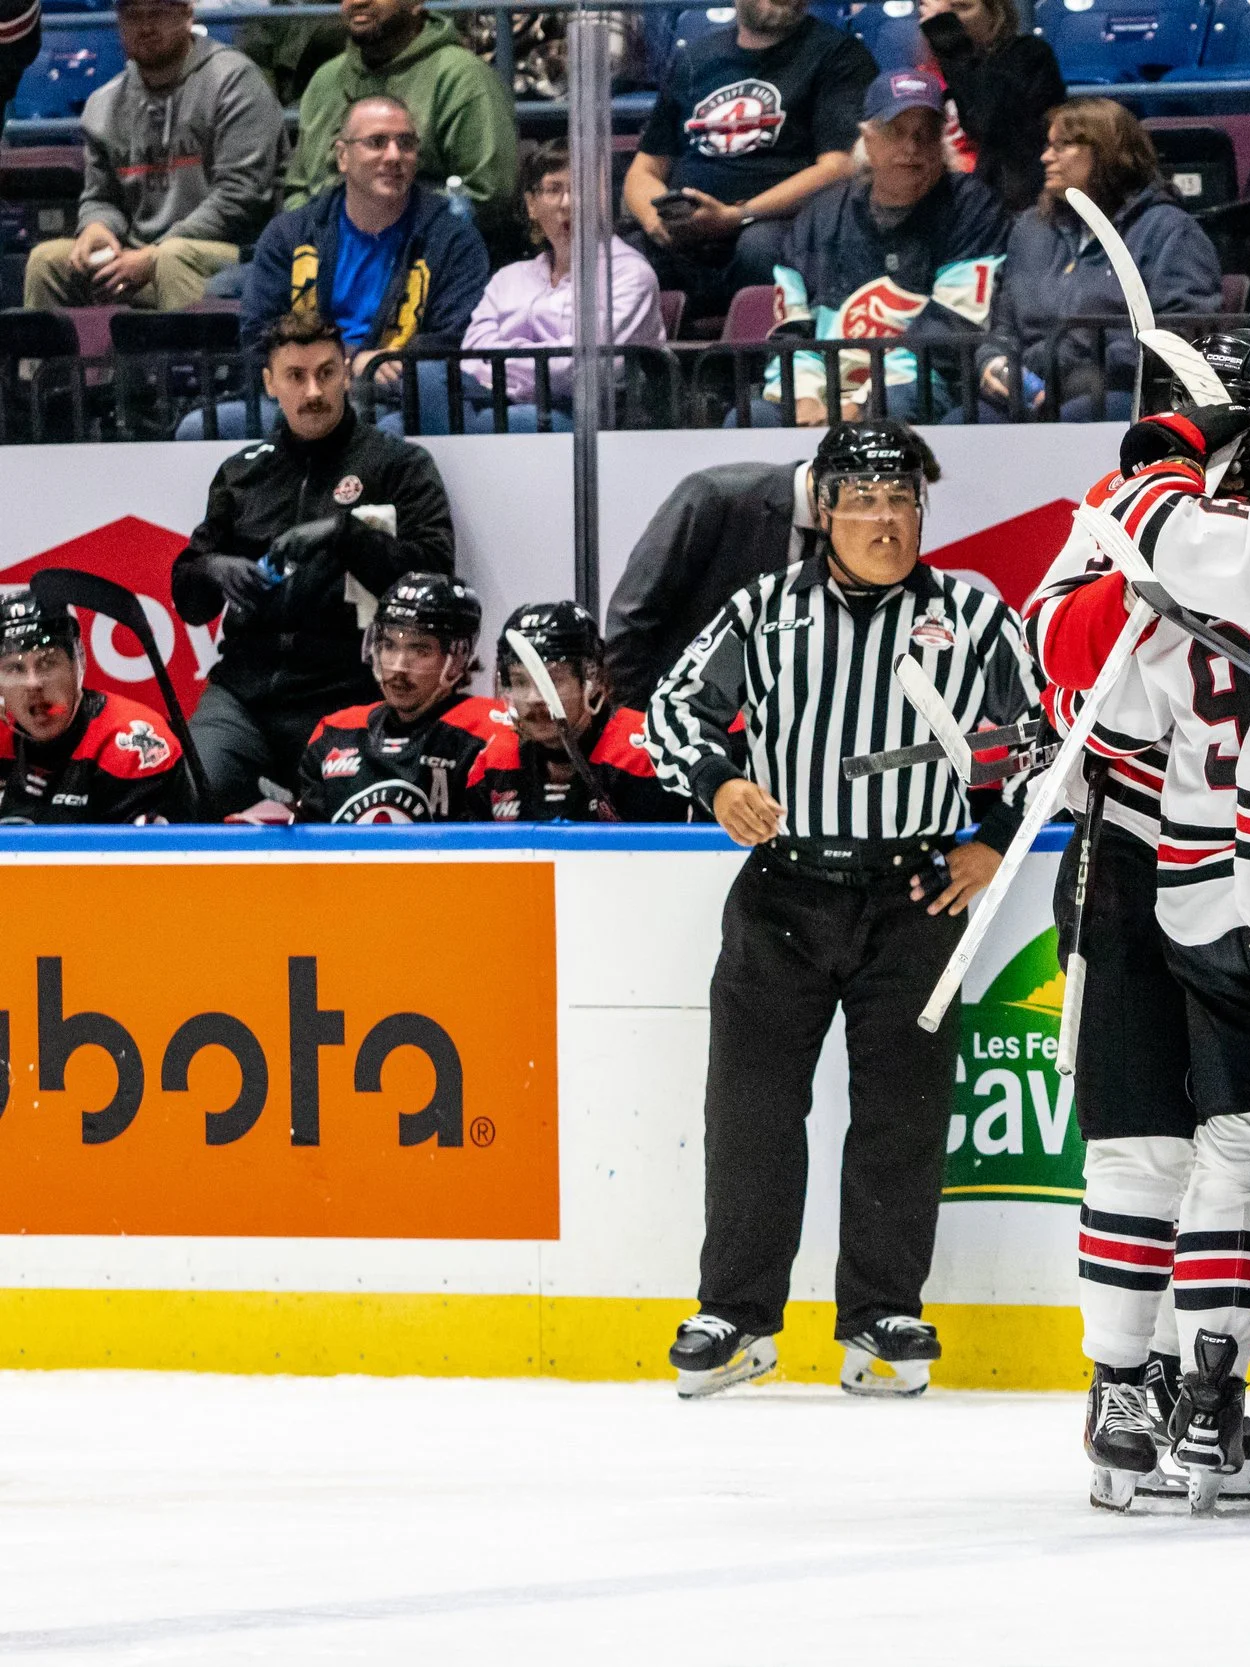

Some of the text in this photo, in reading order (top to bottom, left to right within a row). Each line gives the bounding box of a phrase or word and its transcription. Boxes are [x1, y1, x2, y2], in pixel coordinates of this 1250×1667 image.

[1206, 354, 1243, 365] COOPER
[866, 449, 901, 459] CCM
[762, 617, 813, 635] CCM
[321, 756, 362, 776] WHL
[429, 767, 450, 817] A
[0, 956, 464, 1148] bota
[973, 1032, 1021, 1060] Les
[1201, 1334, 1227, 1345] CCM
